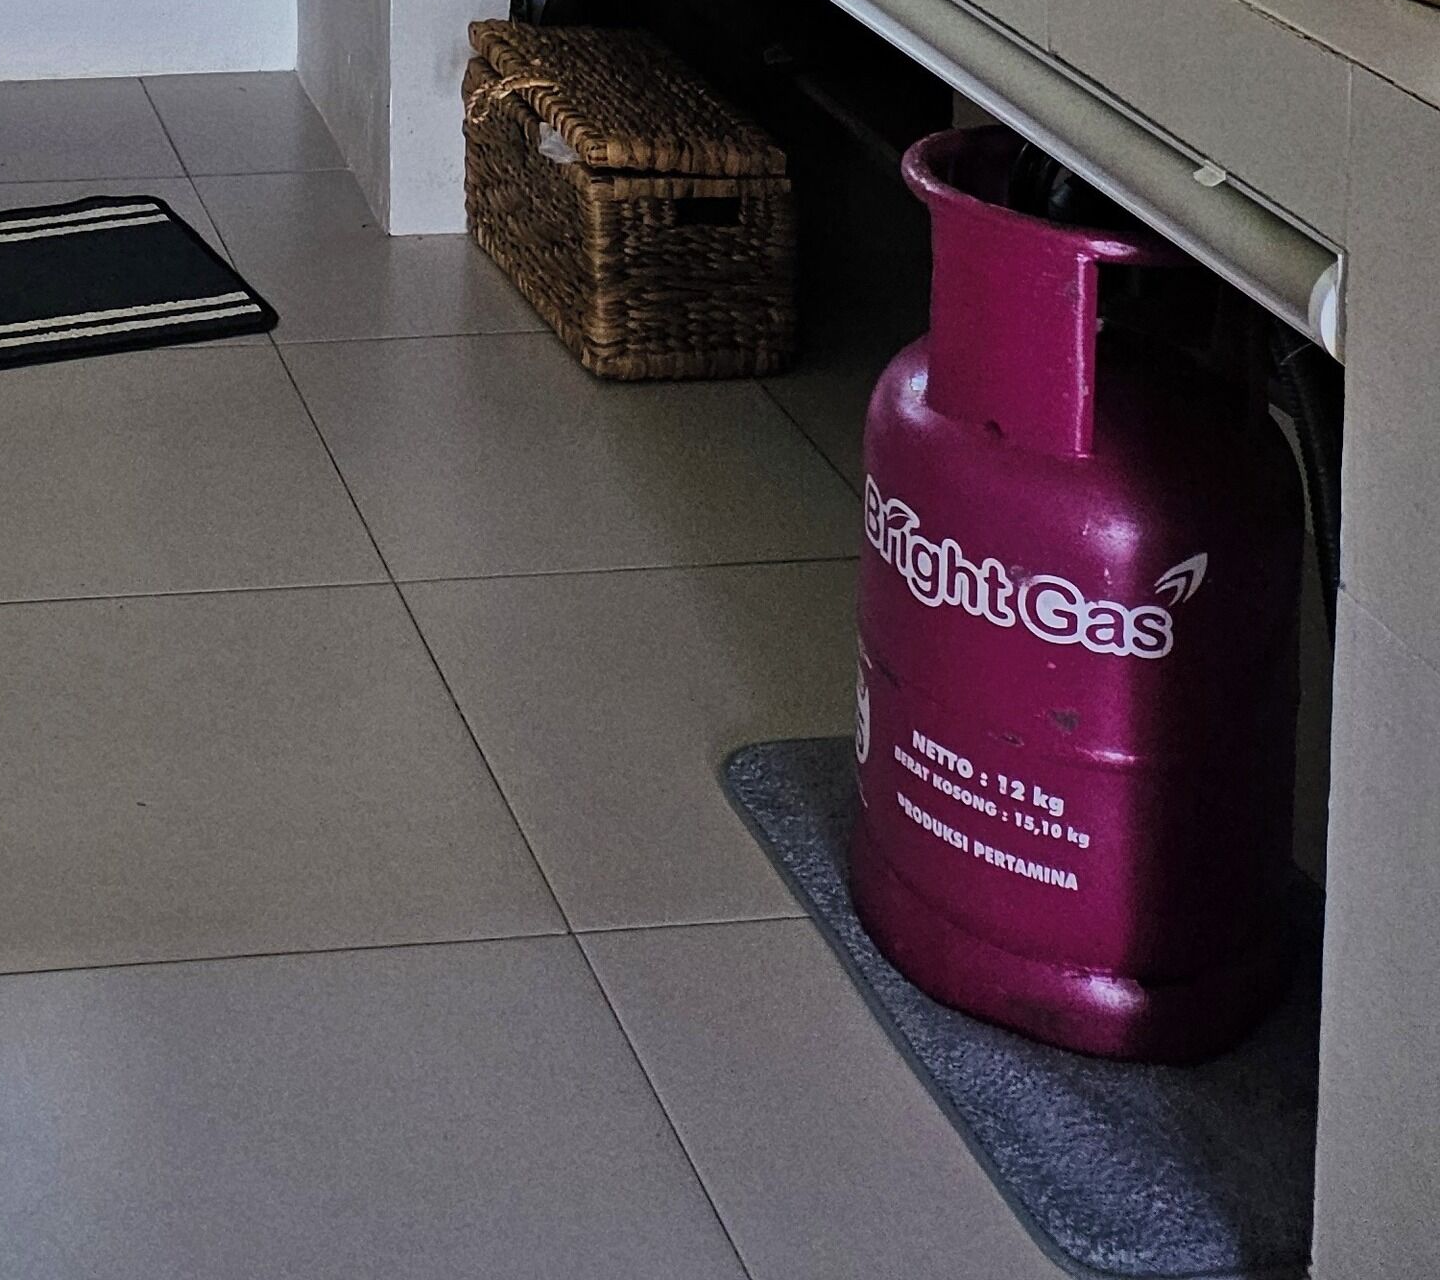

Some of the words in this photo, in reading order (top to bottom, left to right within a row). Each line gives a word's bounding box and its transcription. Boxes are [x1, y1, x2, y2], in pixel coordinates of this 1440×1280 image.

[864, 473, 1016, 628] Bright
[1018, 575, 1173, 659] Gas
[893, 745, 930, 782] BERAT
[932, 772, 998, 817] KOSONG
[1015, 811, 1062, 838] 15,10
[1067, 826, 1090, 849] kg
[912, 729, 974, 779] NETTO
[997, 773, 1026, 802] 12
[1032, 785, 1065, 817] kg
[896, 791, 969, 853] PRODUKSI
[973, 840, 1078, 891] PERTAMINA
